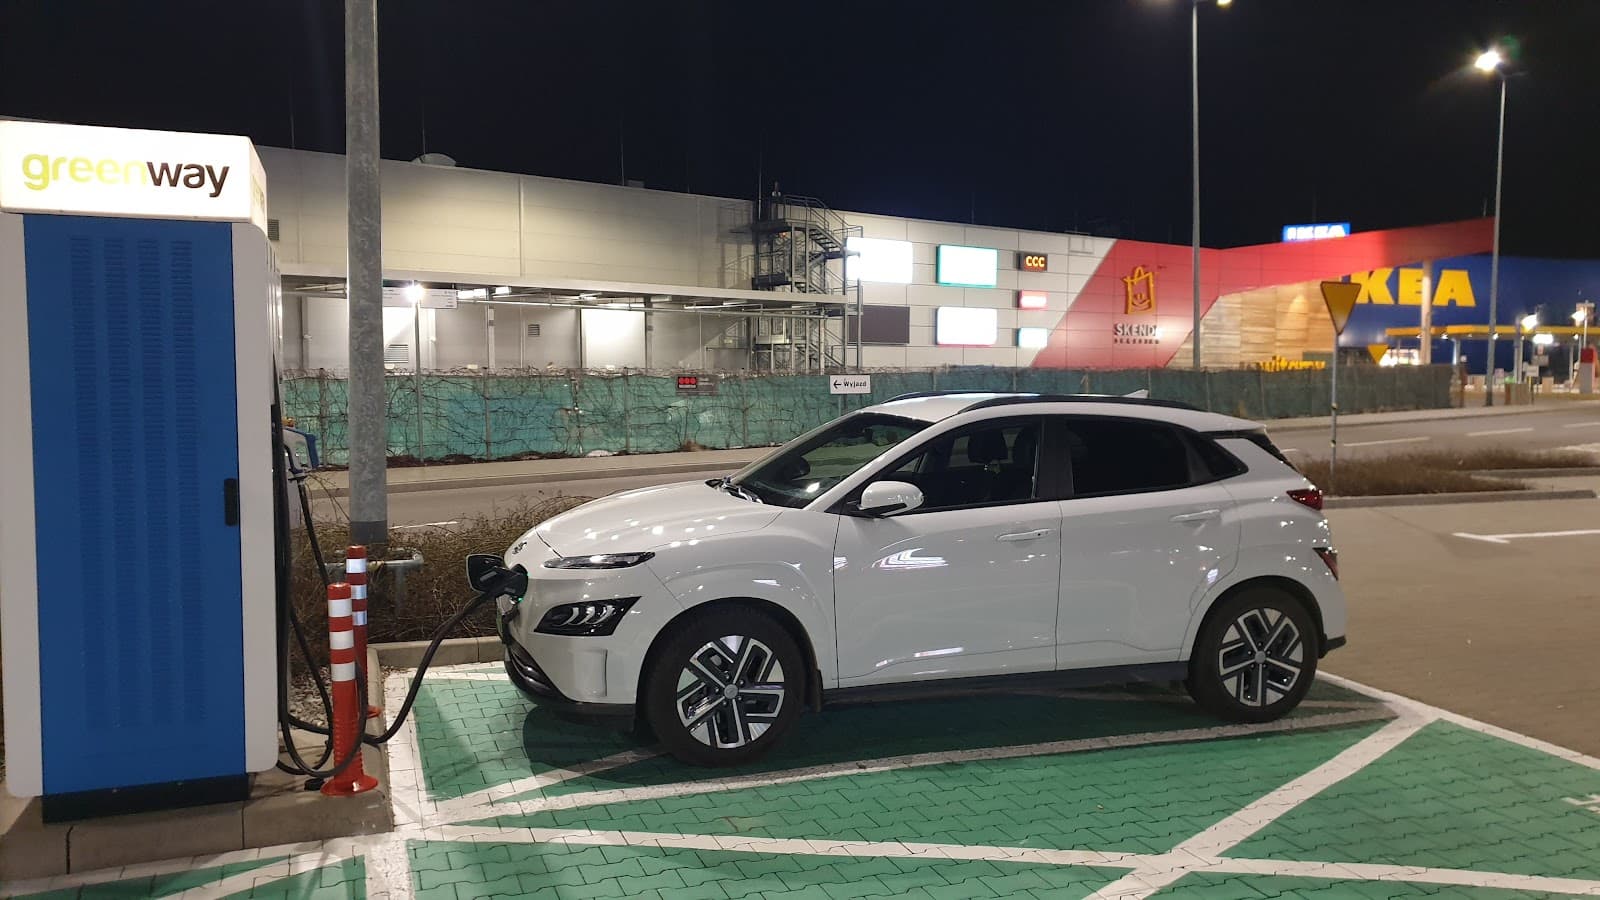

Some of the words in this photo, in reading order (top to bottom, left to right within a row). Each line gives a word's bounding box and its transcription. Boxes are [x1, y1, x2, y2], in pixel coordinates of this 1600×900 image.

[22, 153, 230, 198] greenway
[1287, 225, 1346, 240] IKEA
[1025, 255, 1046, 268] CCC
[1350, 267, 1477, 307] KEA
[1114, 323, 1161, 337] SKEND
[843, 380, 867, 388] Wyjazd
